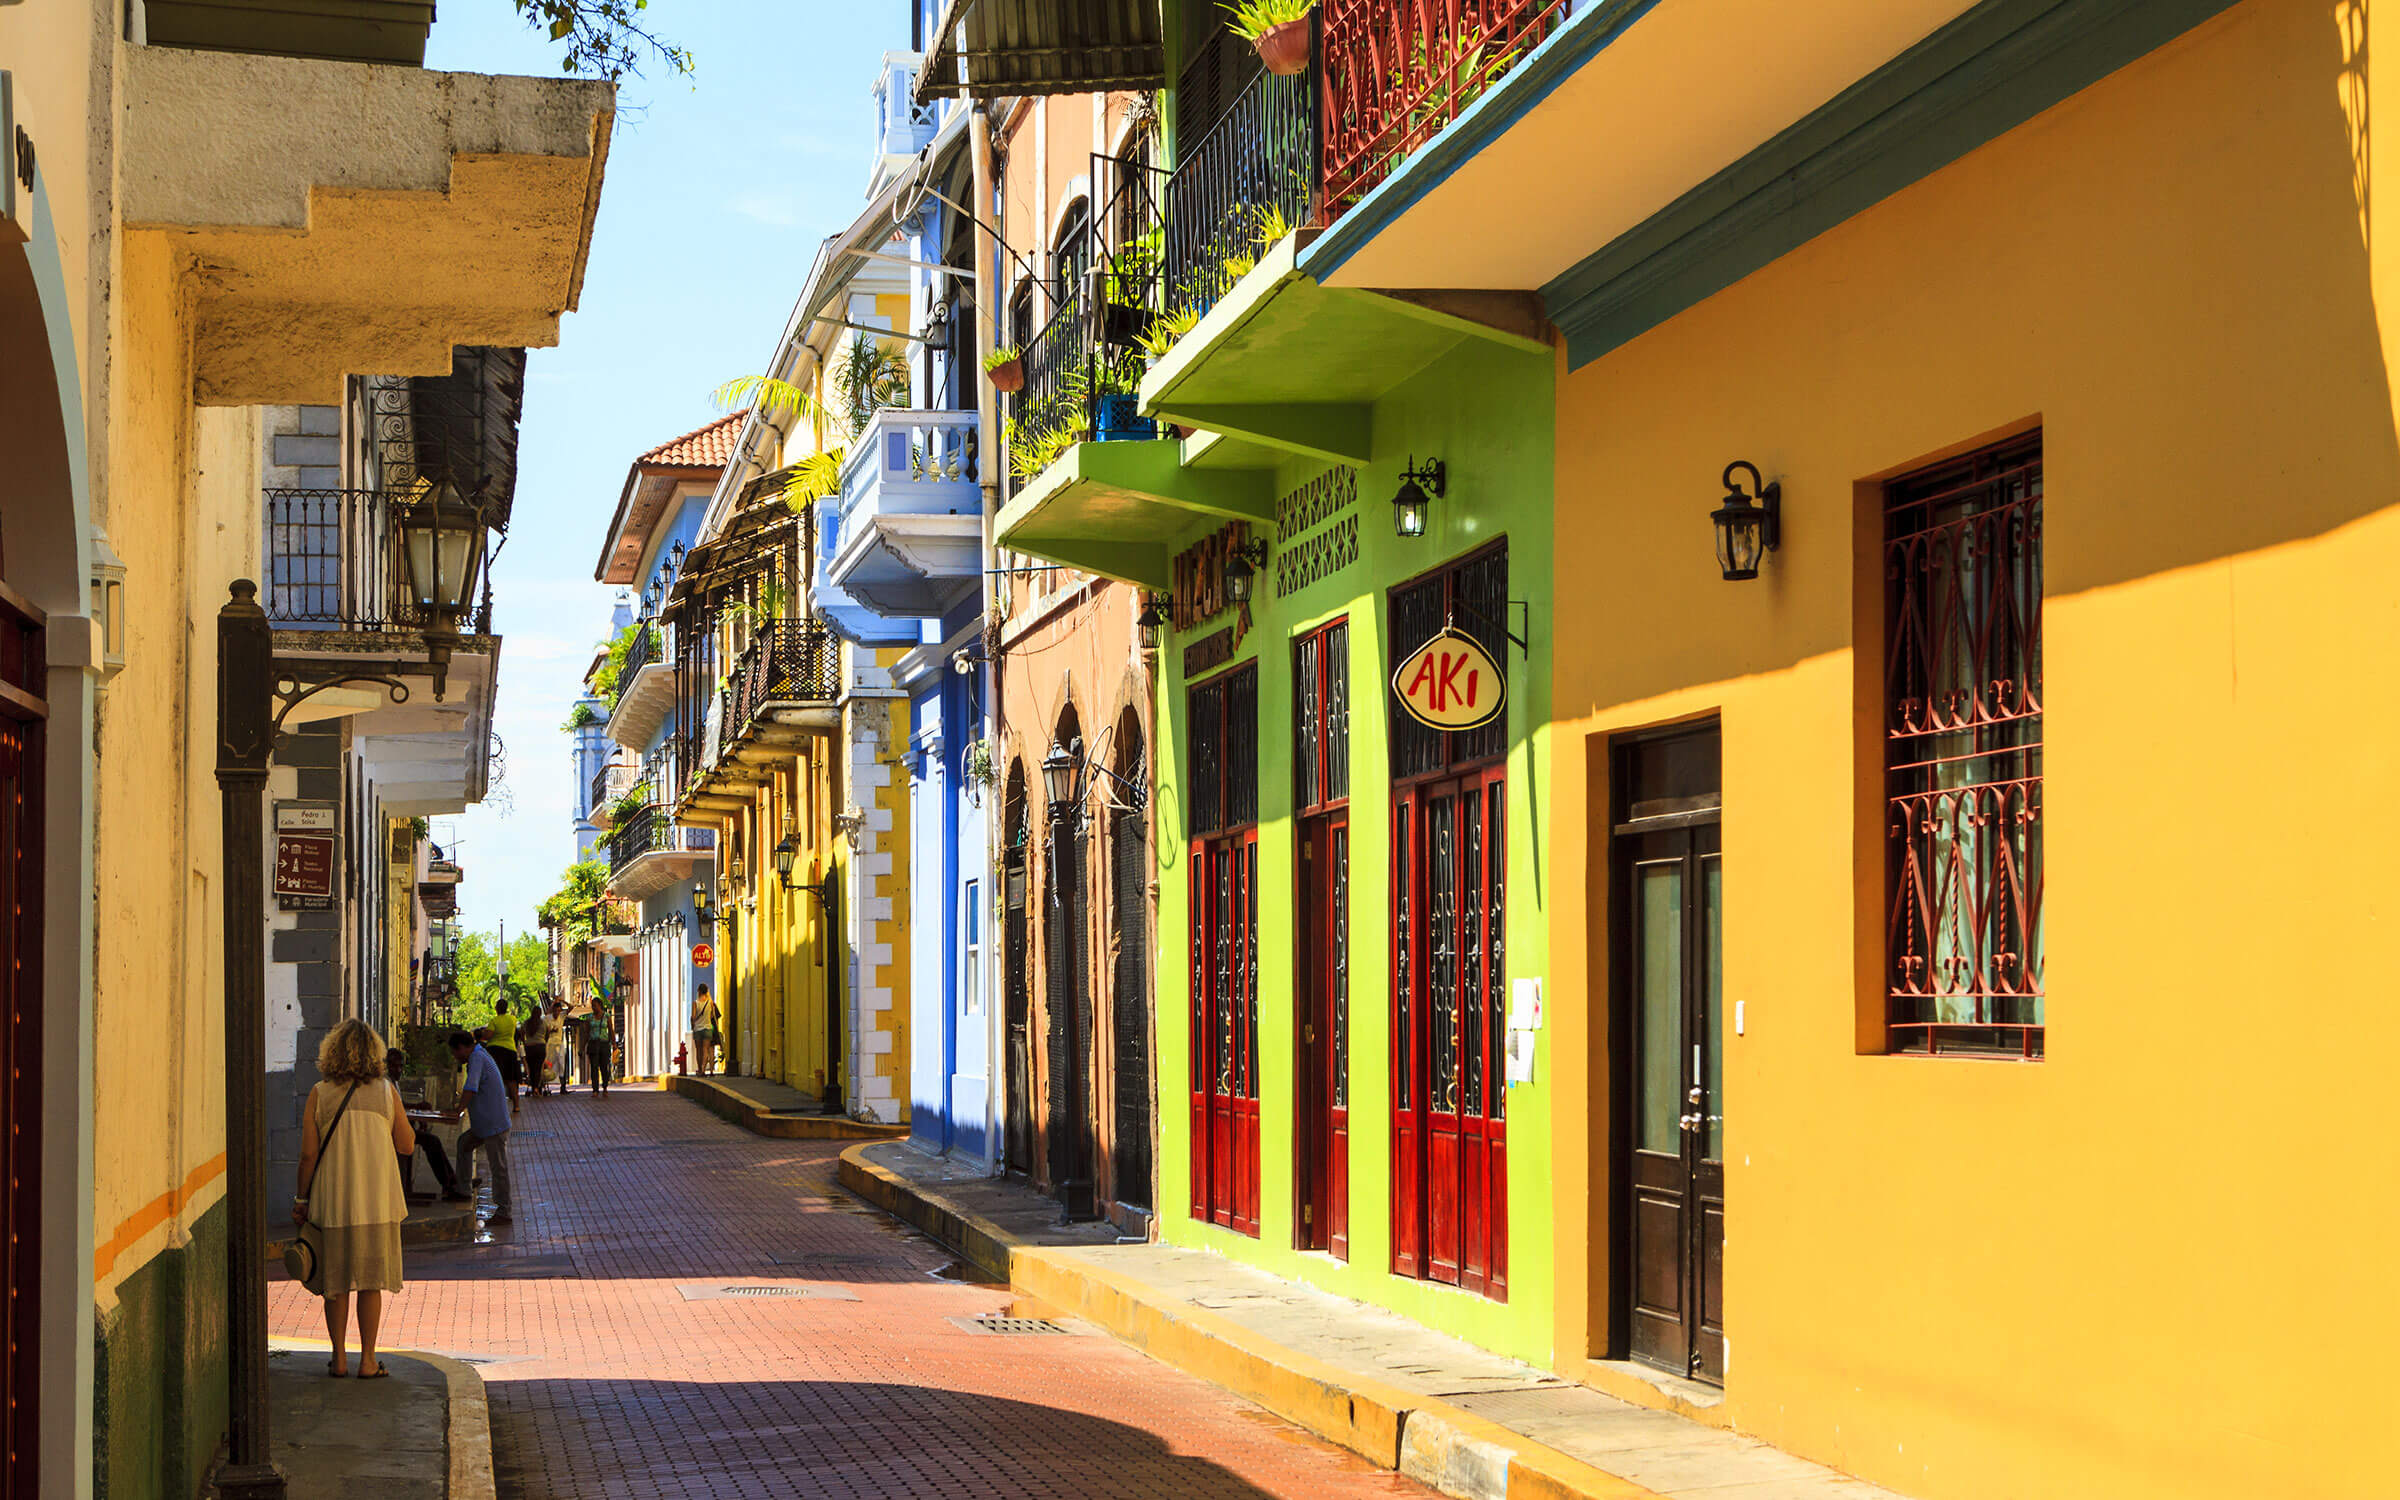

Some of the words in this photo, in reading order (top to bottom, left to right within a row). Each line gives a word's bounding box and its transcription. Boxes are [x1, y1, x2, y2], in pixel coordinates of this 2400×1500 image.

[1407, 652, 1478, 712] AKI
[301, 810, 319, 818] Pedro
[695, 951, 711, 959] ALTO
